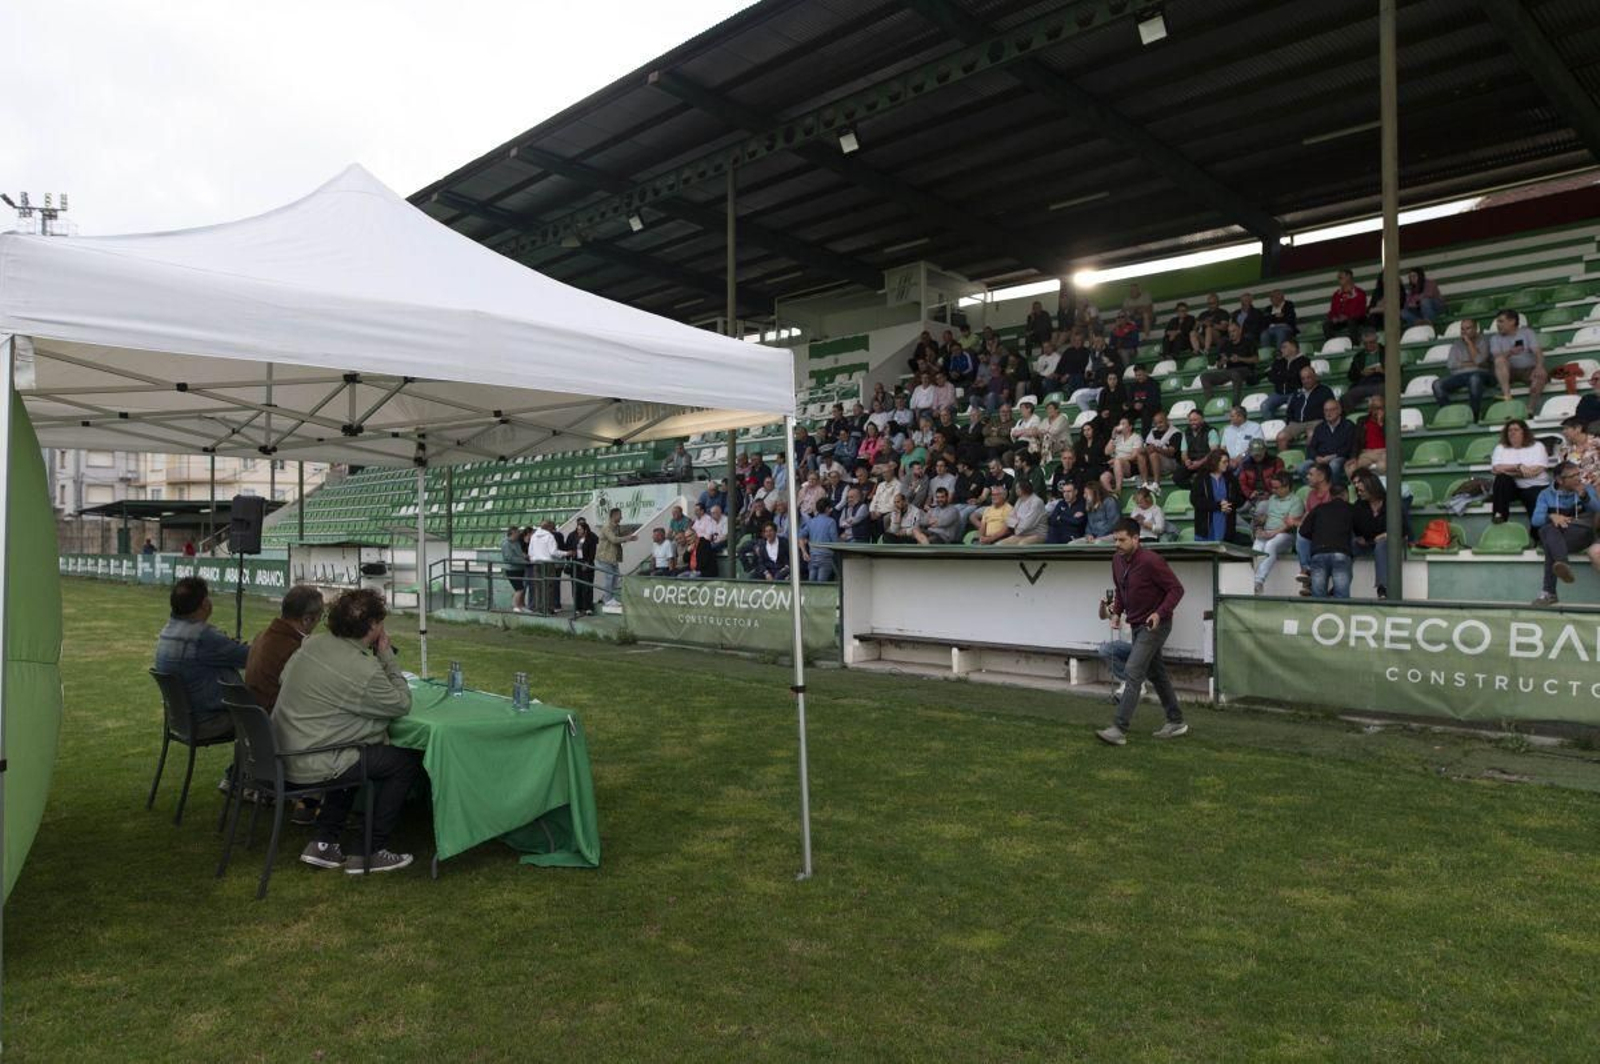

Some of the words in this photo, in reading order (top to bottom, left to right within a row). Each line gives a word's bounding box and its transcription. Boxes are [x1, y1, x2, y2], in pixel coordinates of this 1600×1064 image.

[198, 566, 220, 581] ABANCA
[224, 567, 250, 584] ABACA
[255, 569, 285, 587] ABANCA
[653, 584, 710, 606] ORECO
[713, 584, 792, 611] BALGÓN
[678, 614, 760, 629] CONSTRUCTORA
[1311, 612, 1492, 656] ORECO
